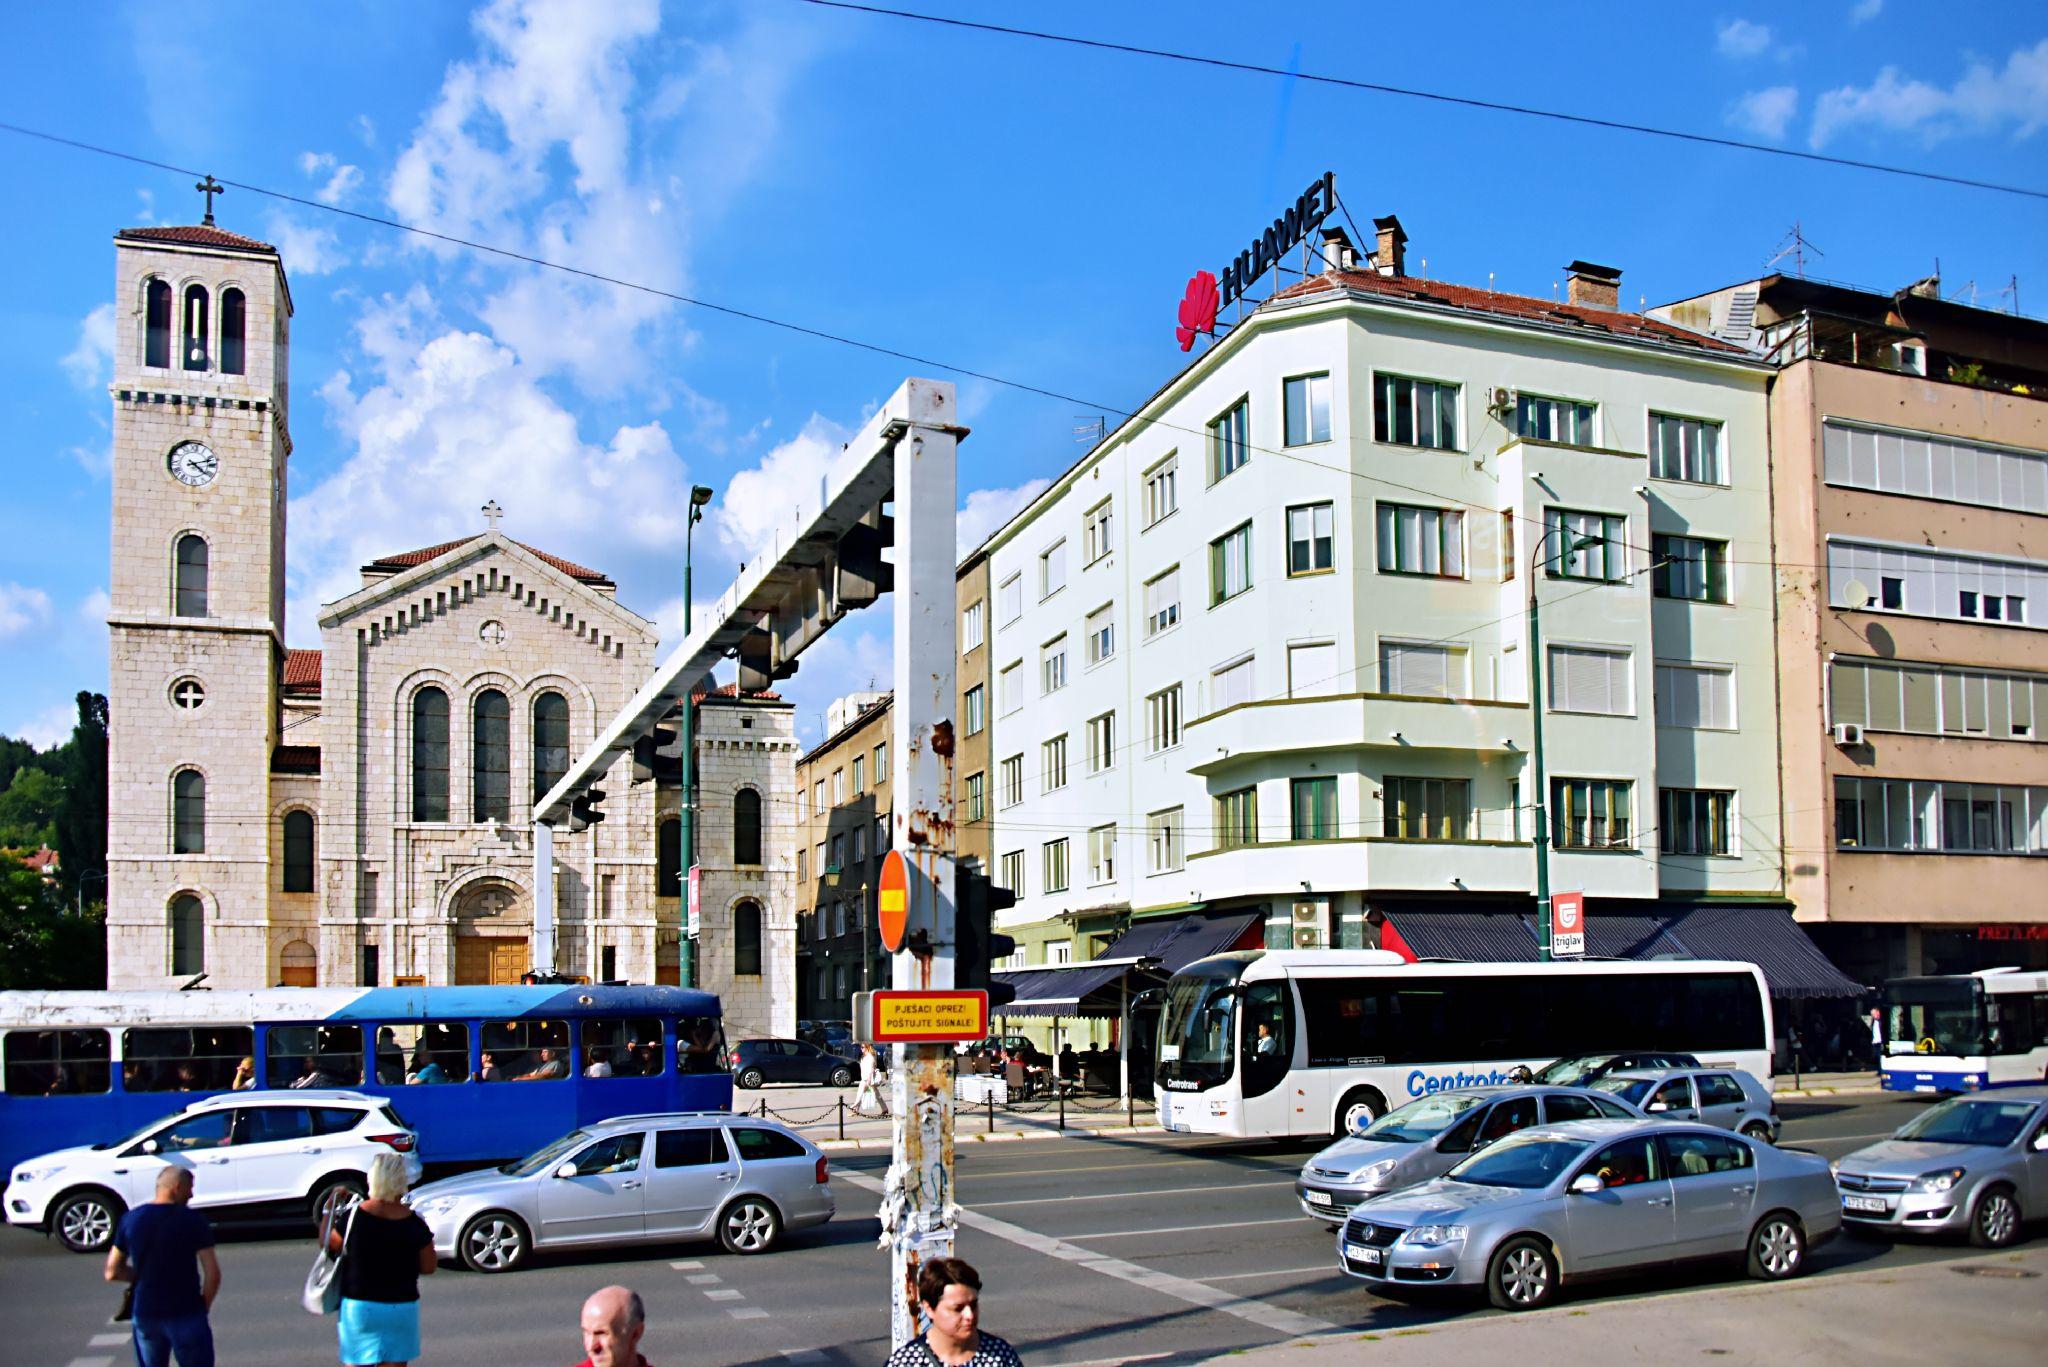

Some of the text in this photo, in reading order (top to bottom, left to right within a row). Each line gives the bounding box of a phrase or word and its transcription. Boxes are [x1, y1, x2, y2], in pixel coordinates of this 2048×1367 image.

[1222, 171, 1335, 306] HUAWEI
[1556, 935, 1582, 949] triglav
[895, 1003, 967, 1014] PJEŠACI OPREZ!
[887, 1018, 974, 1028] POŠTUJTE SIGNALE!
[1167, 1078, 1199, 1090] Centrotrans
[1407, 1068, 1514, 1097] Centrotr
